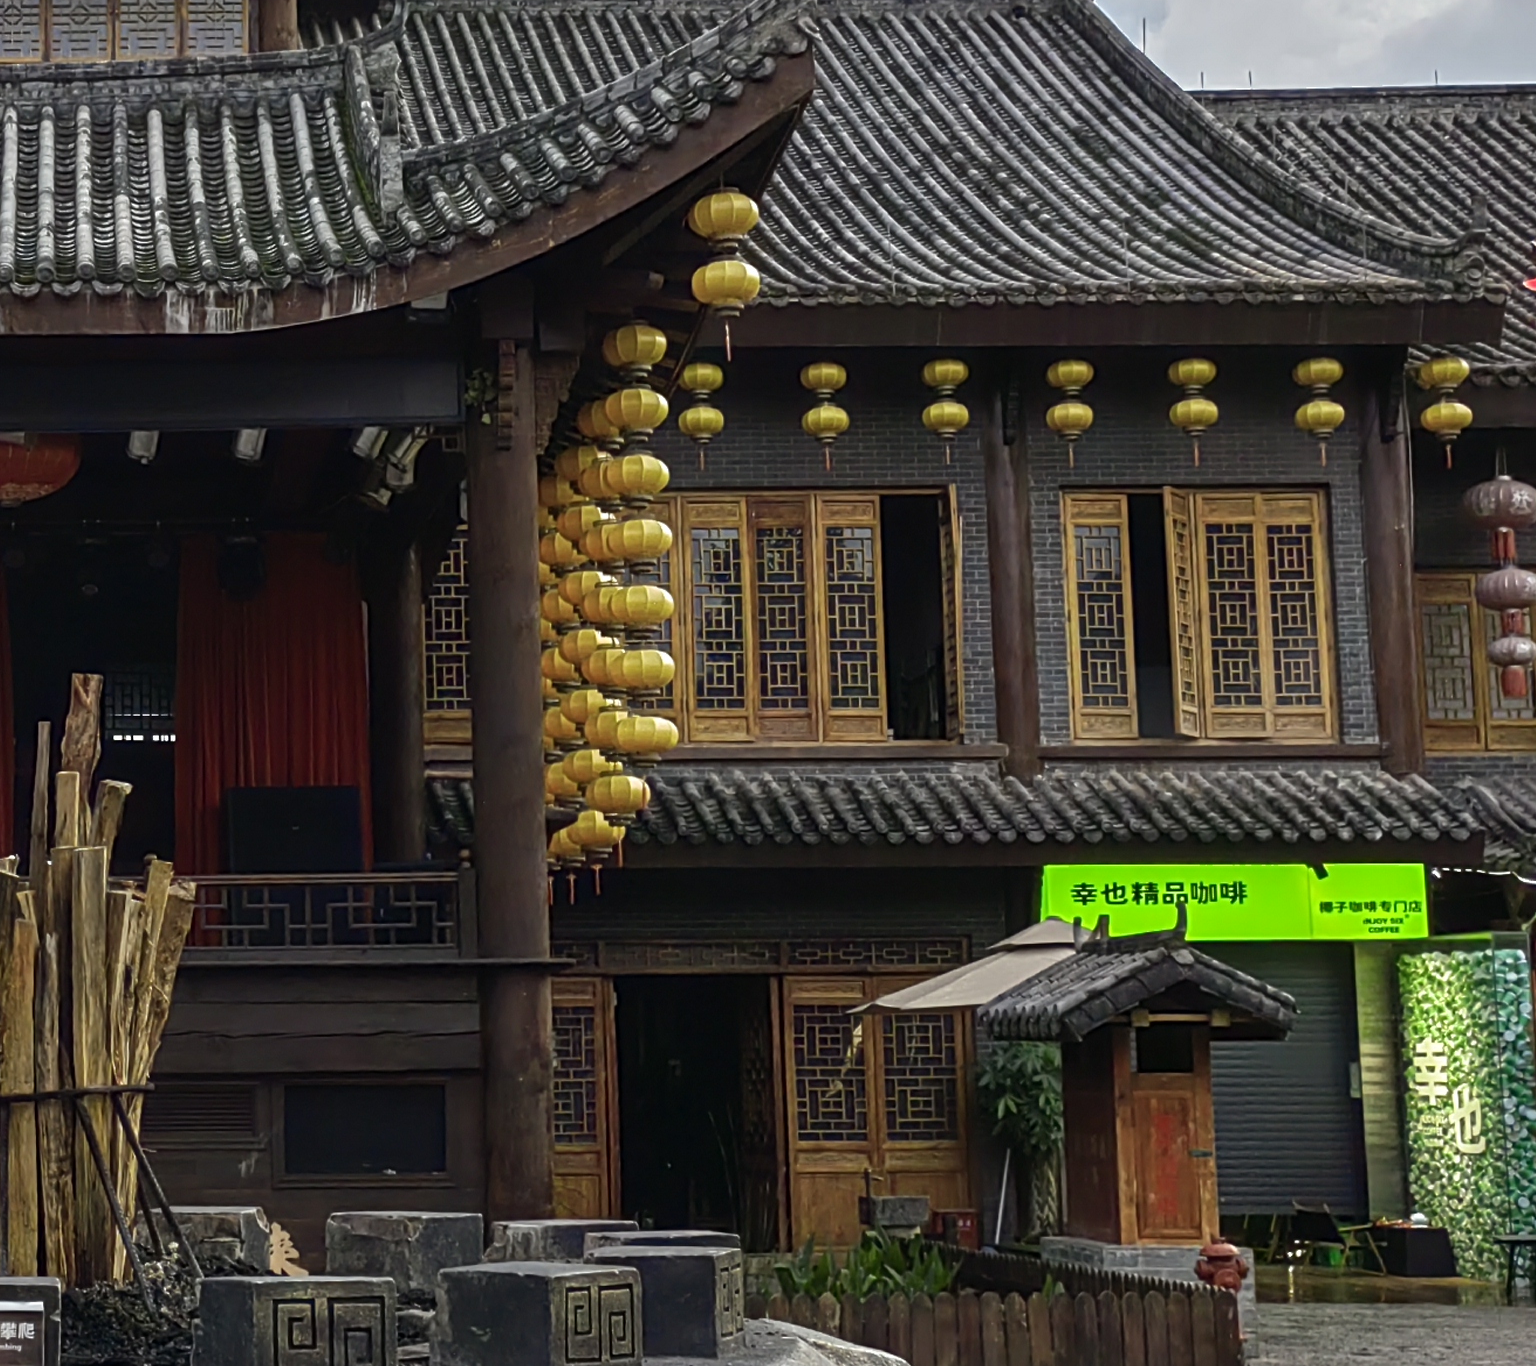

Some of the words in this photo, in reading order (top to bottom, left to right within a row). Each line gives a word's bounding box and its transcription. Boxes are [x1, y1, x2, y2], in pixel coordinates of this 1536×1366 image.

[1070, 881, 1248, 906] 幸也精品咖啡
[1368, 926, 1400, 934] COFFEE
